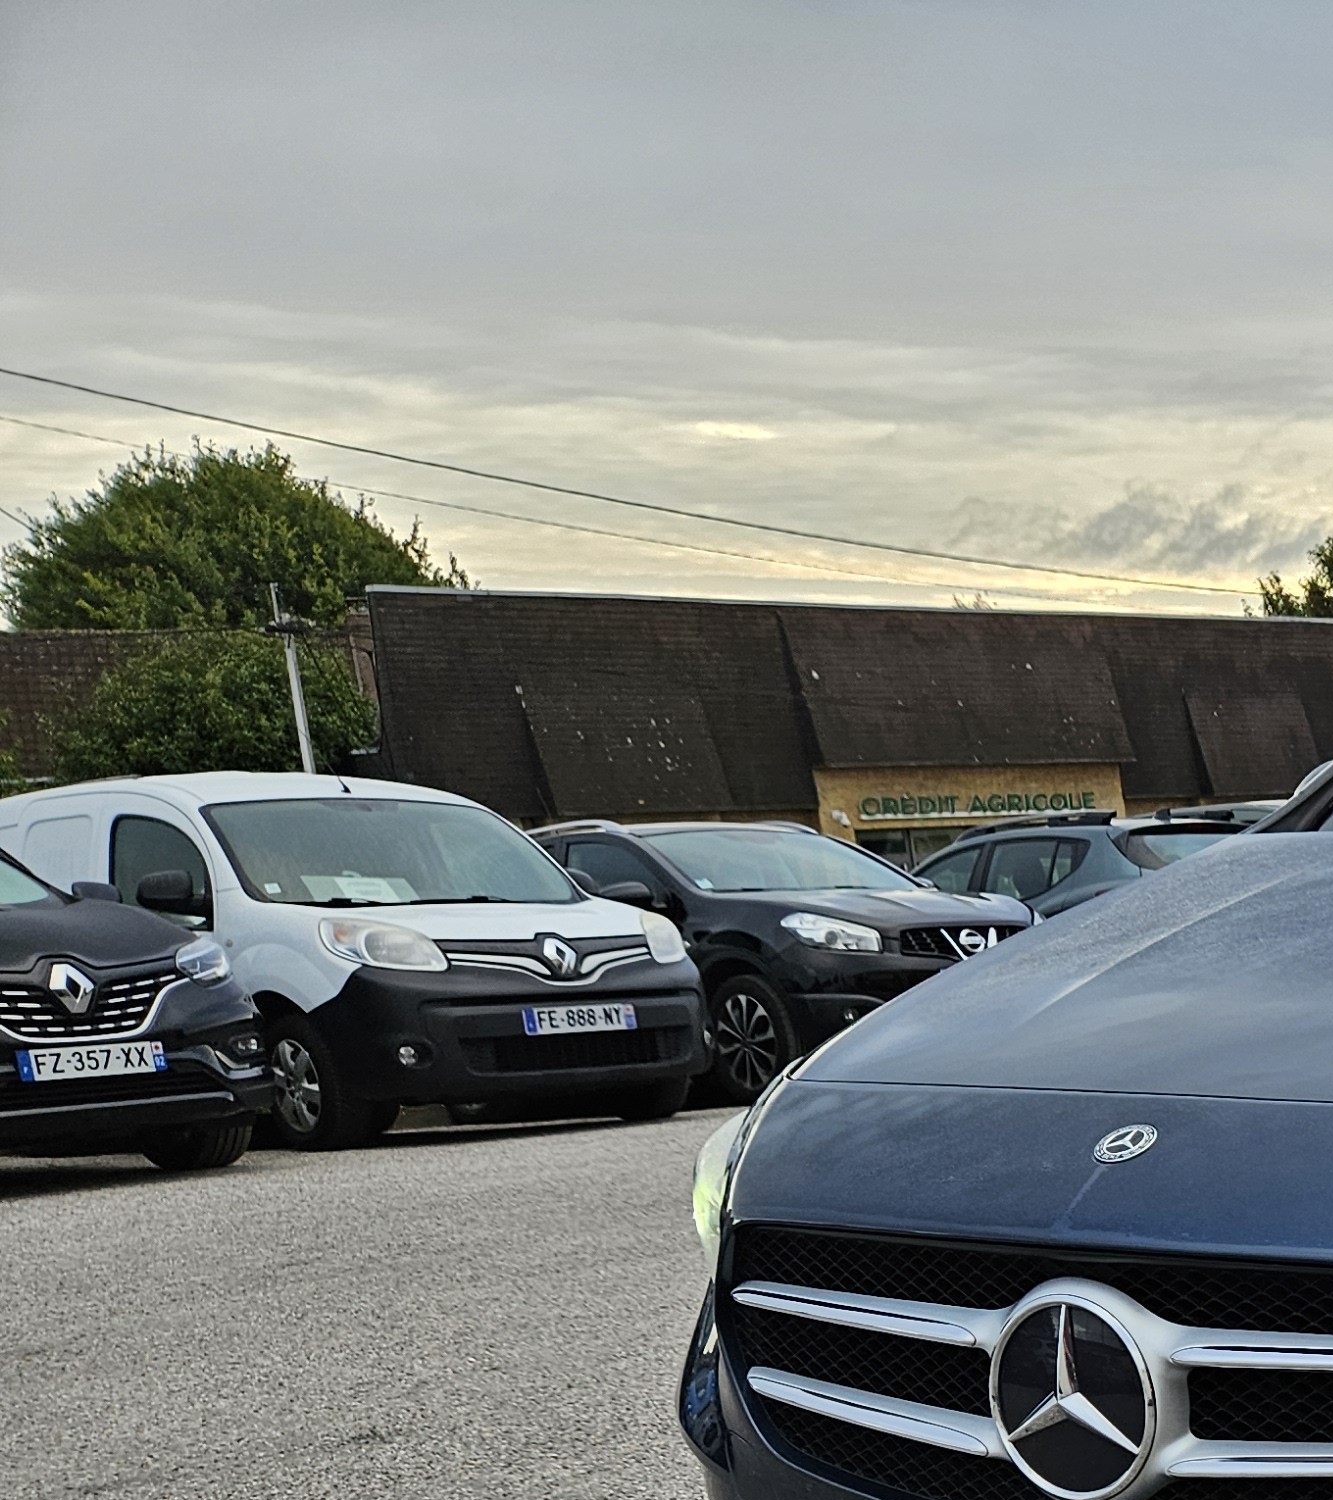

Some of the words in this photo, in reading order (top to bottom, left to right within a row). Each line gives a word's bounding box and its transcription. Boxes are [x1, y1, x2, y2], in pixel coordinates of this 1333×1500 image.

[967, 791, 1097, 814] AGRICOLE
[537, 1007, 621, 1030] FE-888-NY
[34, 1046, 149, 1075] FZ-357-XX
